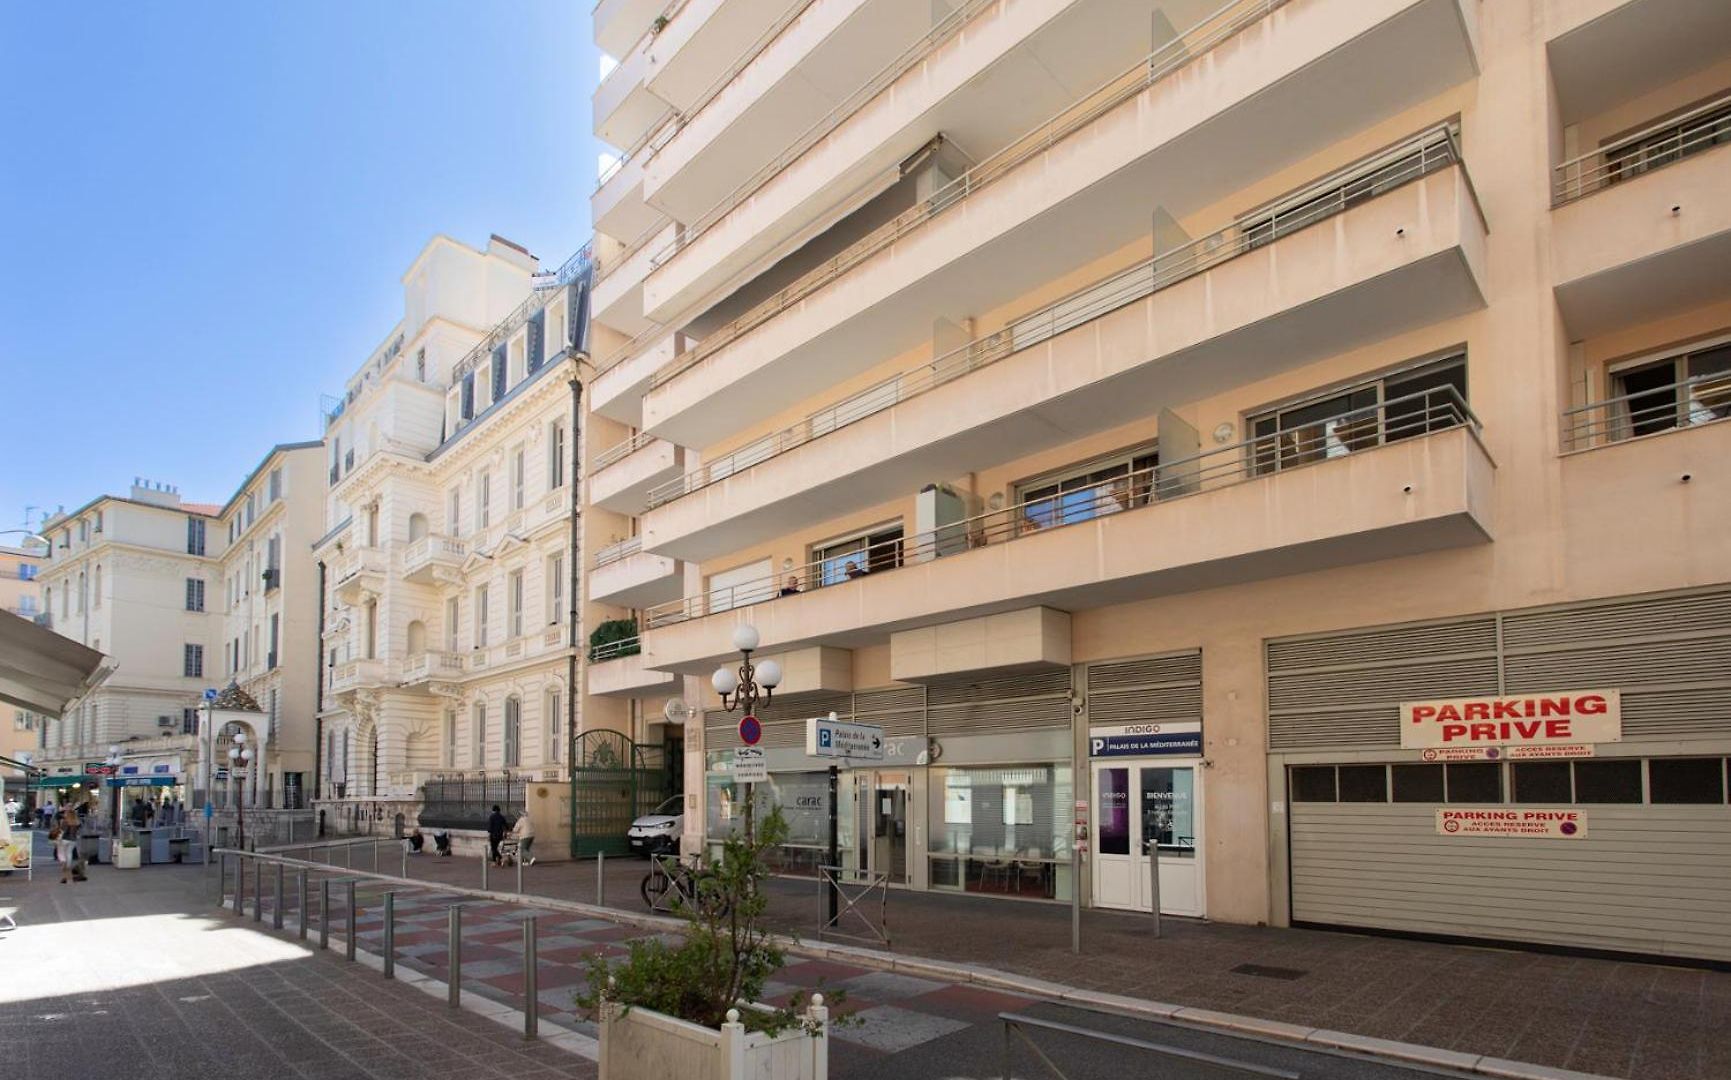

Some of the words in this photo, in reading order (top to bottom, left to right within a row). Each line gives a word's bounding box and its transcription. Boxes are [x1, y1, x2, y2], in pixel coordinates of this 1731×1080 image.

[1412, 695, 1607, 723] PARKING
[1442, 719, 1572, 742] PRIVE
[1092, 739, 1104, 755] P
[1443, 811, 1518, 820] PARKING
[1523, 812, 1578, 821] PRIVE
